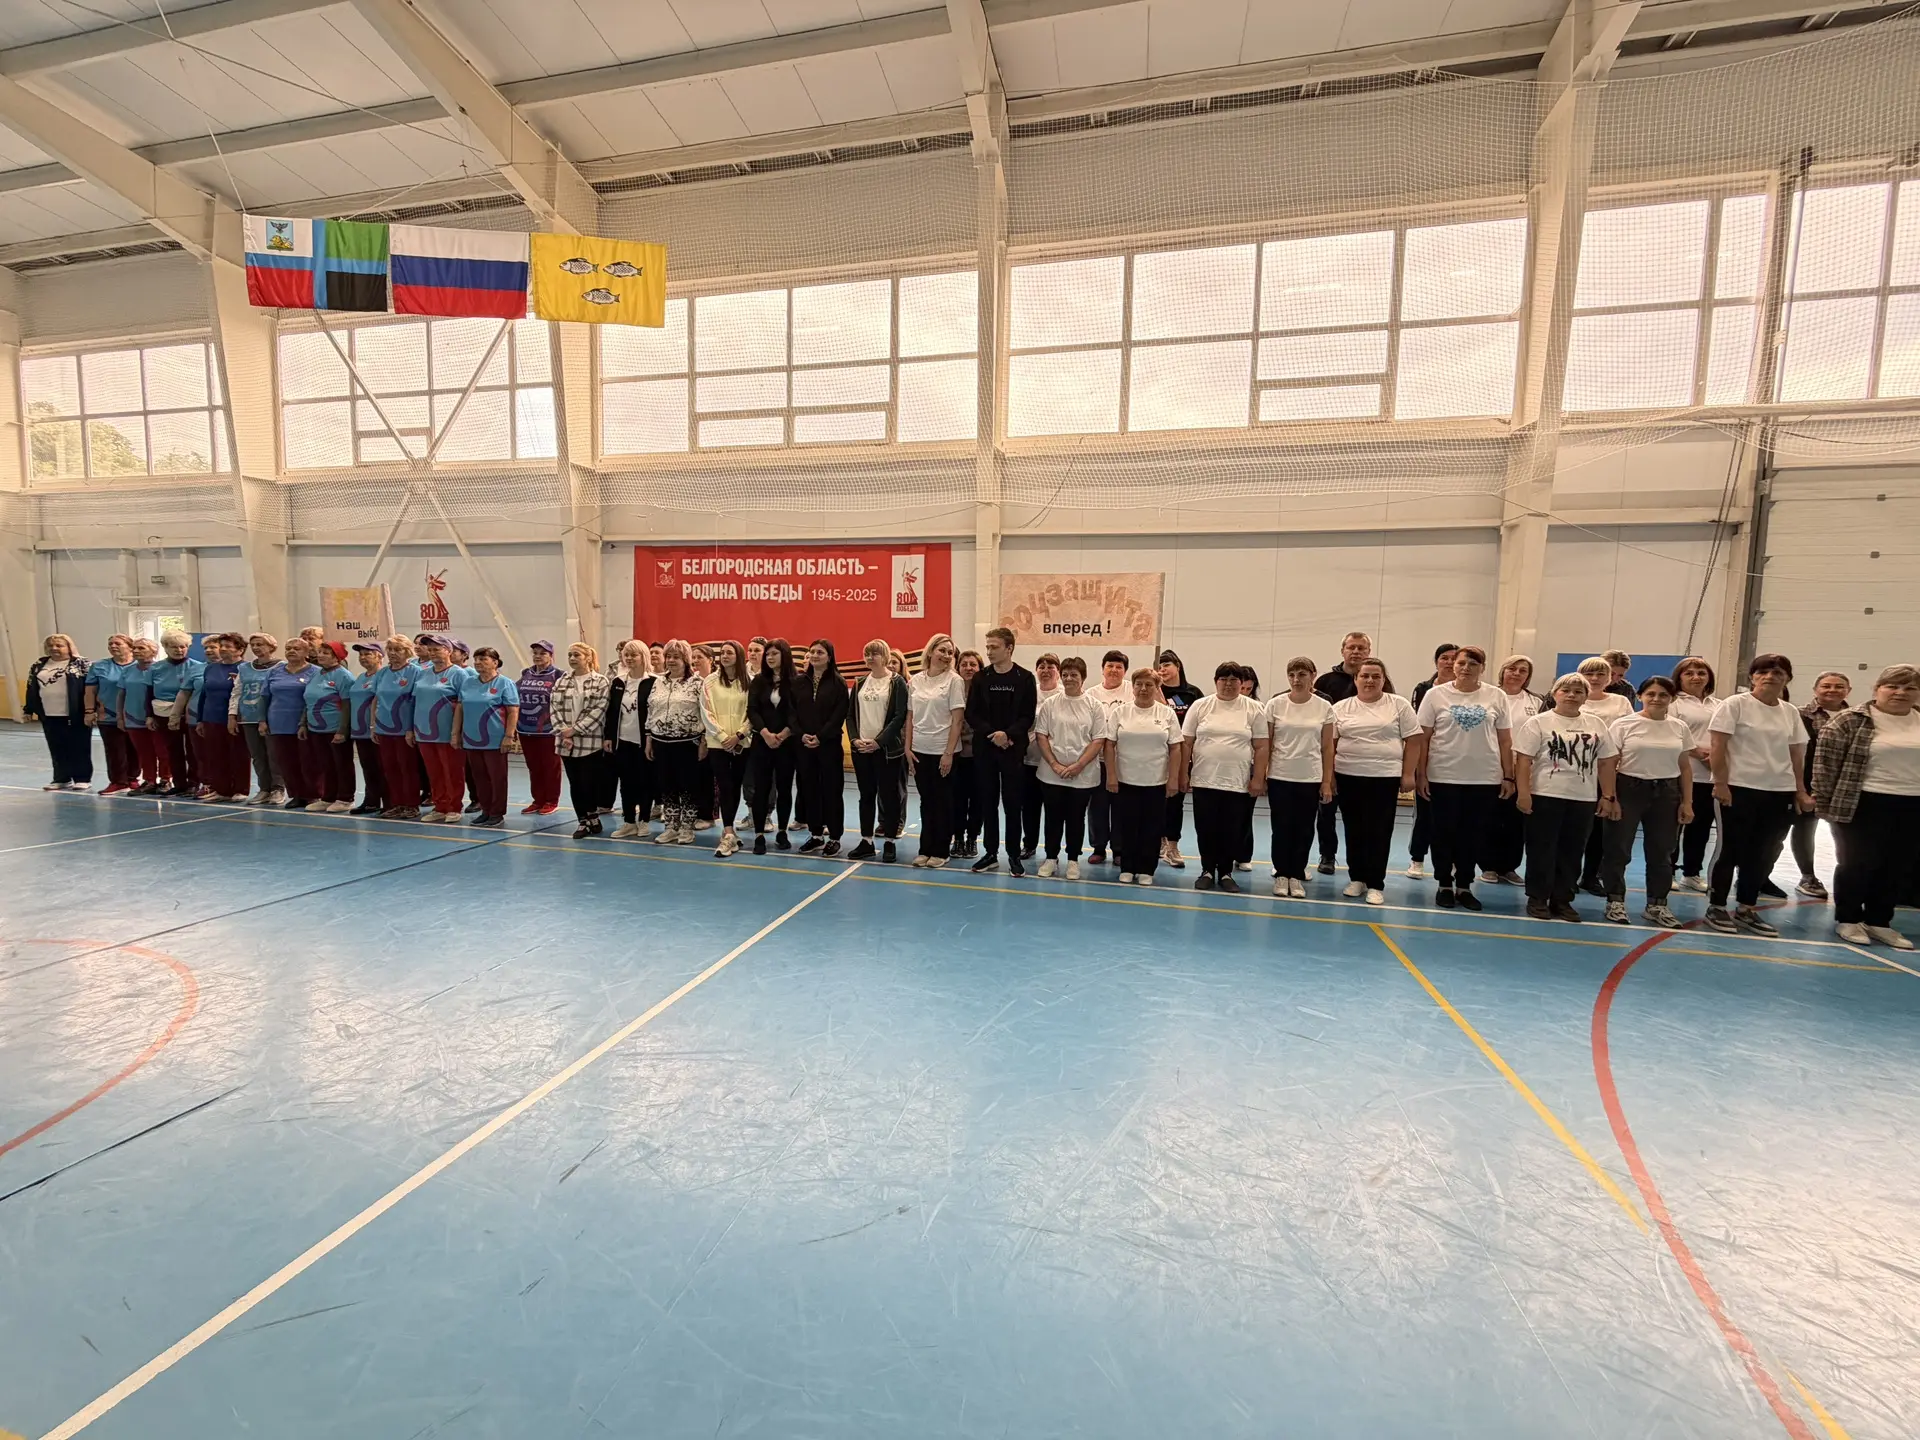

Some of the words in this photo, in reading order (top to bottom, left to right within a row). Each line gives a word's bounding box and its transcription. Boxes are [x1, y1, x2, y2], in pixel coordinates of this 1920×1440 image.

[681, 558, 792, 577] БЕЛГОРОДСКАЯ
[796, 558, 865, 575] ОБЛАСТЬ
[682, 583, 738, 602] РОДИНА
[742, 583, 803, 602] ПОБЕДЫ
[811, 588, 877, 601] 1945-2025
[896, 592, 909, 604] 80
[420, 603, 435, 620] 80
[336, 621, 361, 630] наш
[421, 620, 450, 632] ПОБЕДА!
[1043, 623, 1102, 637] вперед
